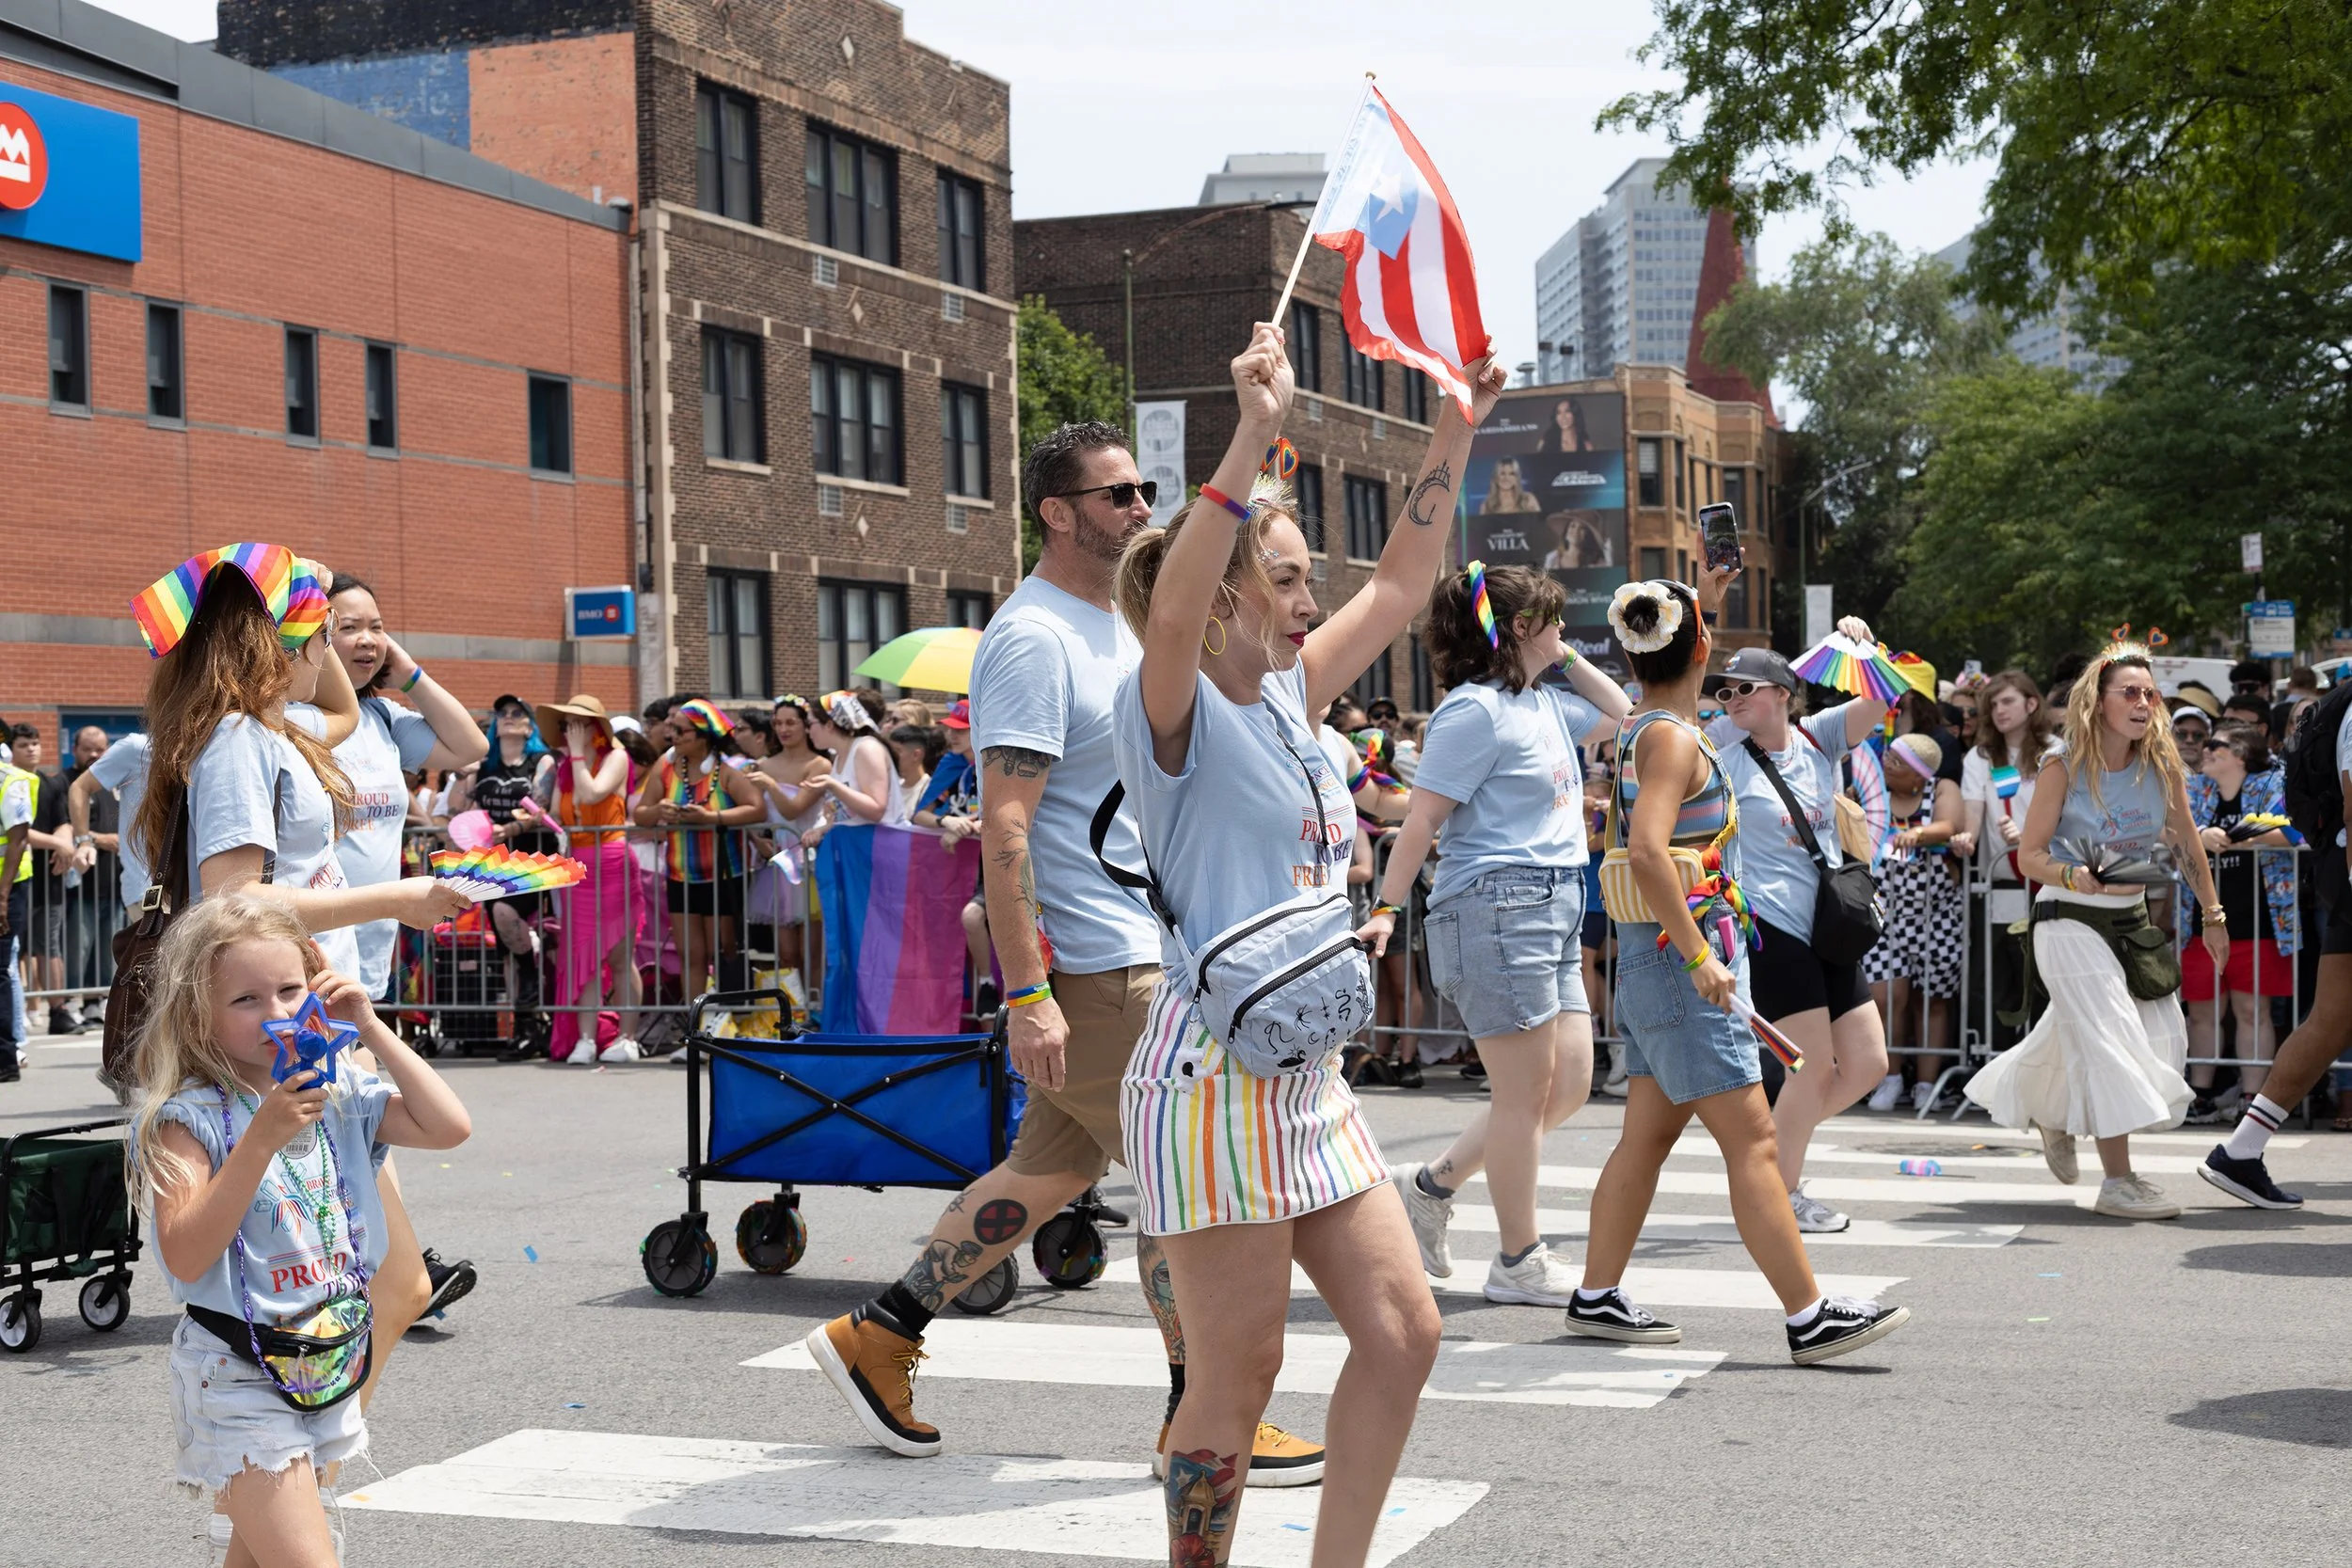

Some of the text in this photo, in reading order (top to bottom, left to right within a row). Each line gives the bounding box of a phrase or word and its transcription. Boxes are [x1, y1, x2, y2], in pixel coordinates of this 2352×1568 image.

[1486, 537, 1531, 551] VILLA
[367, 805, 399, 817] TO BE
[1299, 819, 1342, 844] PROD
[1334, 840, 1352, 862] BE
[1293, 865, 1327, 887] FREE
[269, 1252, 347, 1294] PROUD
